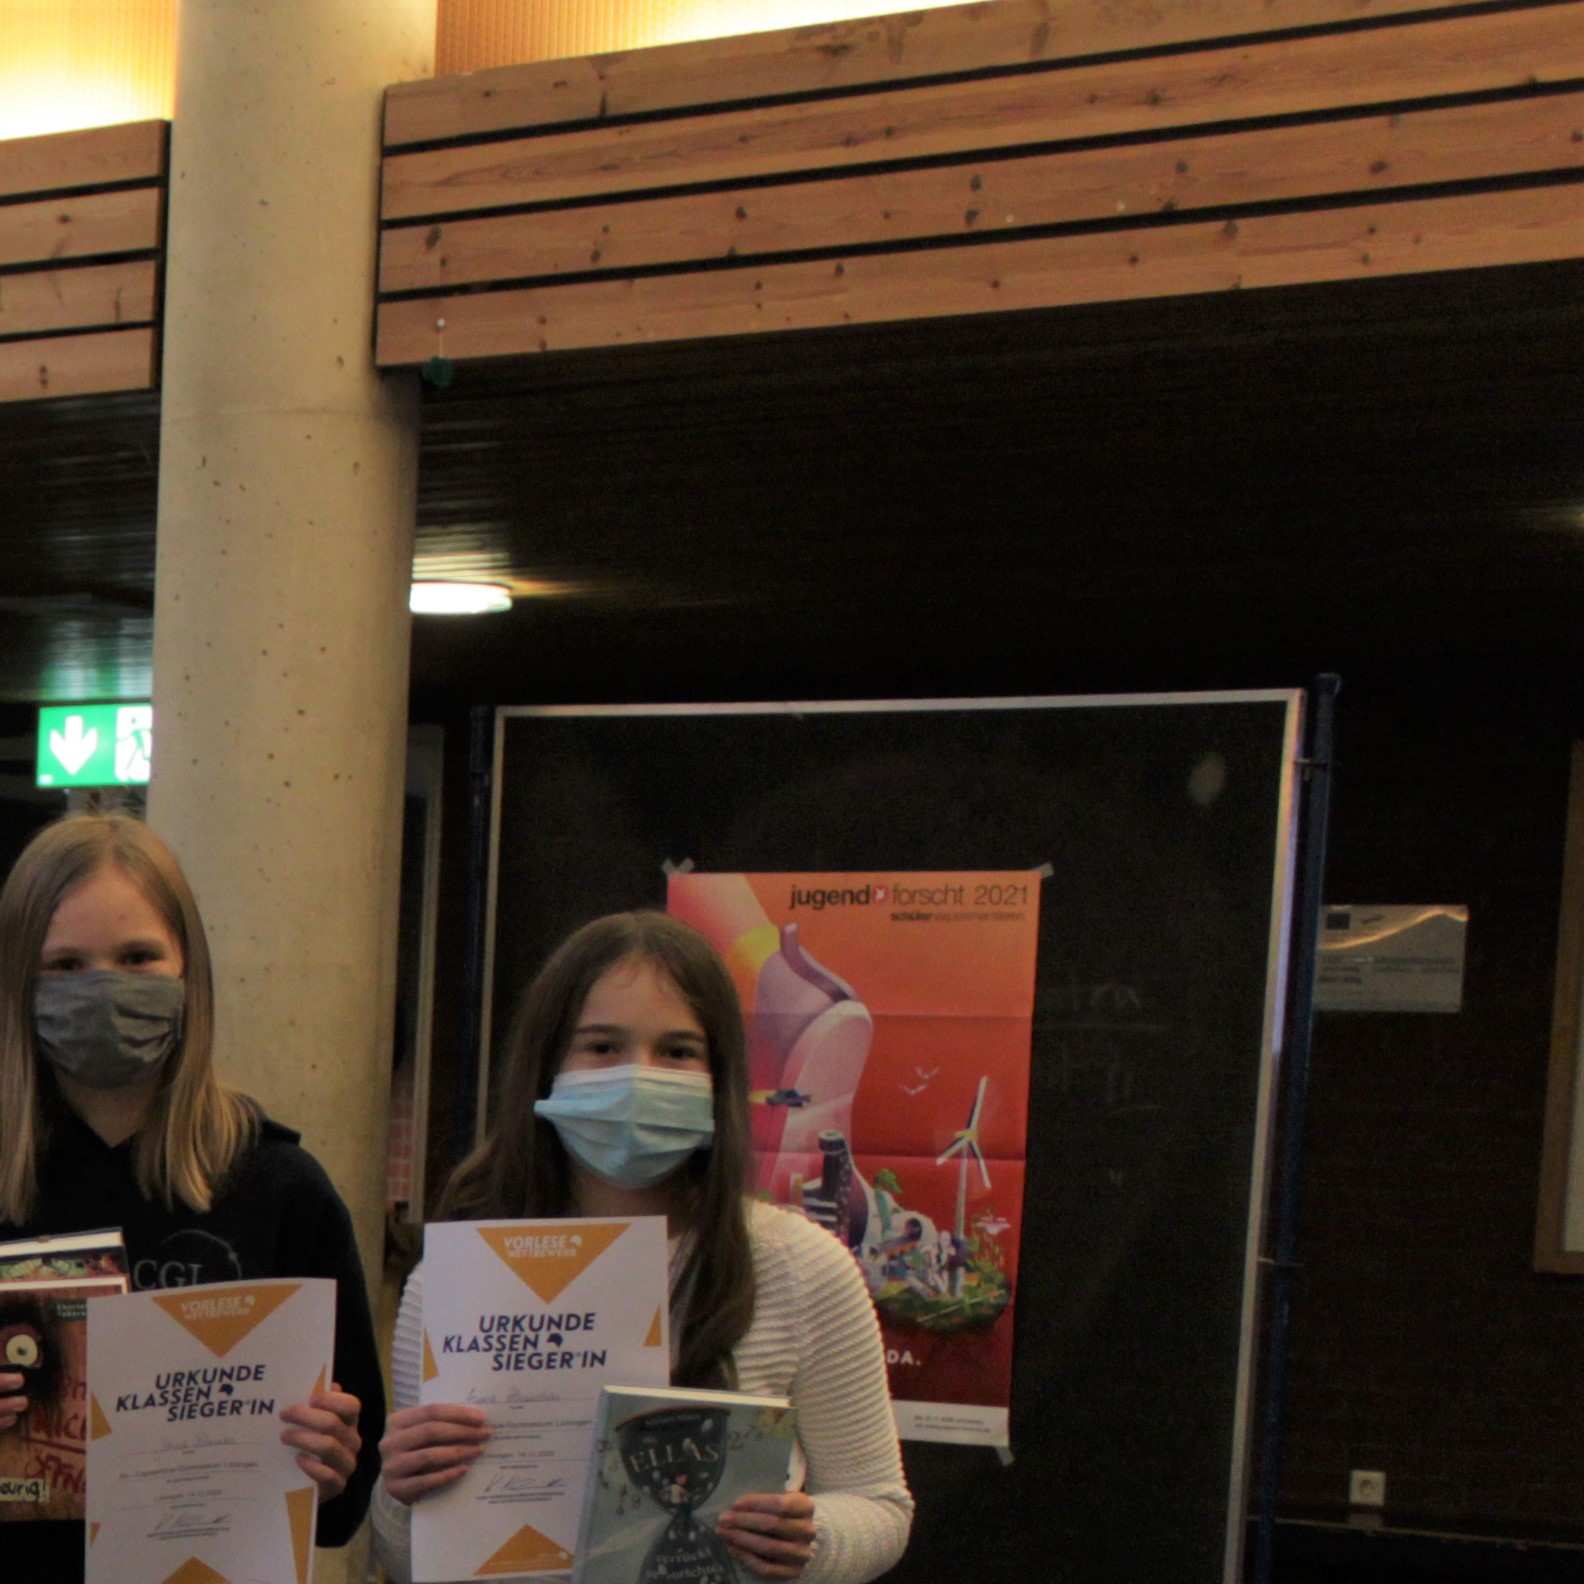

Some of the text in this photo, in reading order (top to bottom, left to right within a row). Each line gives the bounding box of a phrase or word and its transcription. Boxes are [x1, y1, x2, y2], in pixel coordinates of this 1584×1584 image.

[789, 884, 1029, 911] jugend forscht 2021
[503, 1234, 568, 1249] VORLESE
[478, 1312, 596, 1334] URKUNDE
[442, 1333, 539, 1353] KLASSEN
[155, 1364, 266, 1390] URKUNDE
[116, 1385, 211, 1413] KLASSEN
